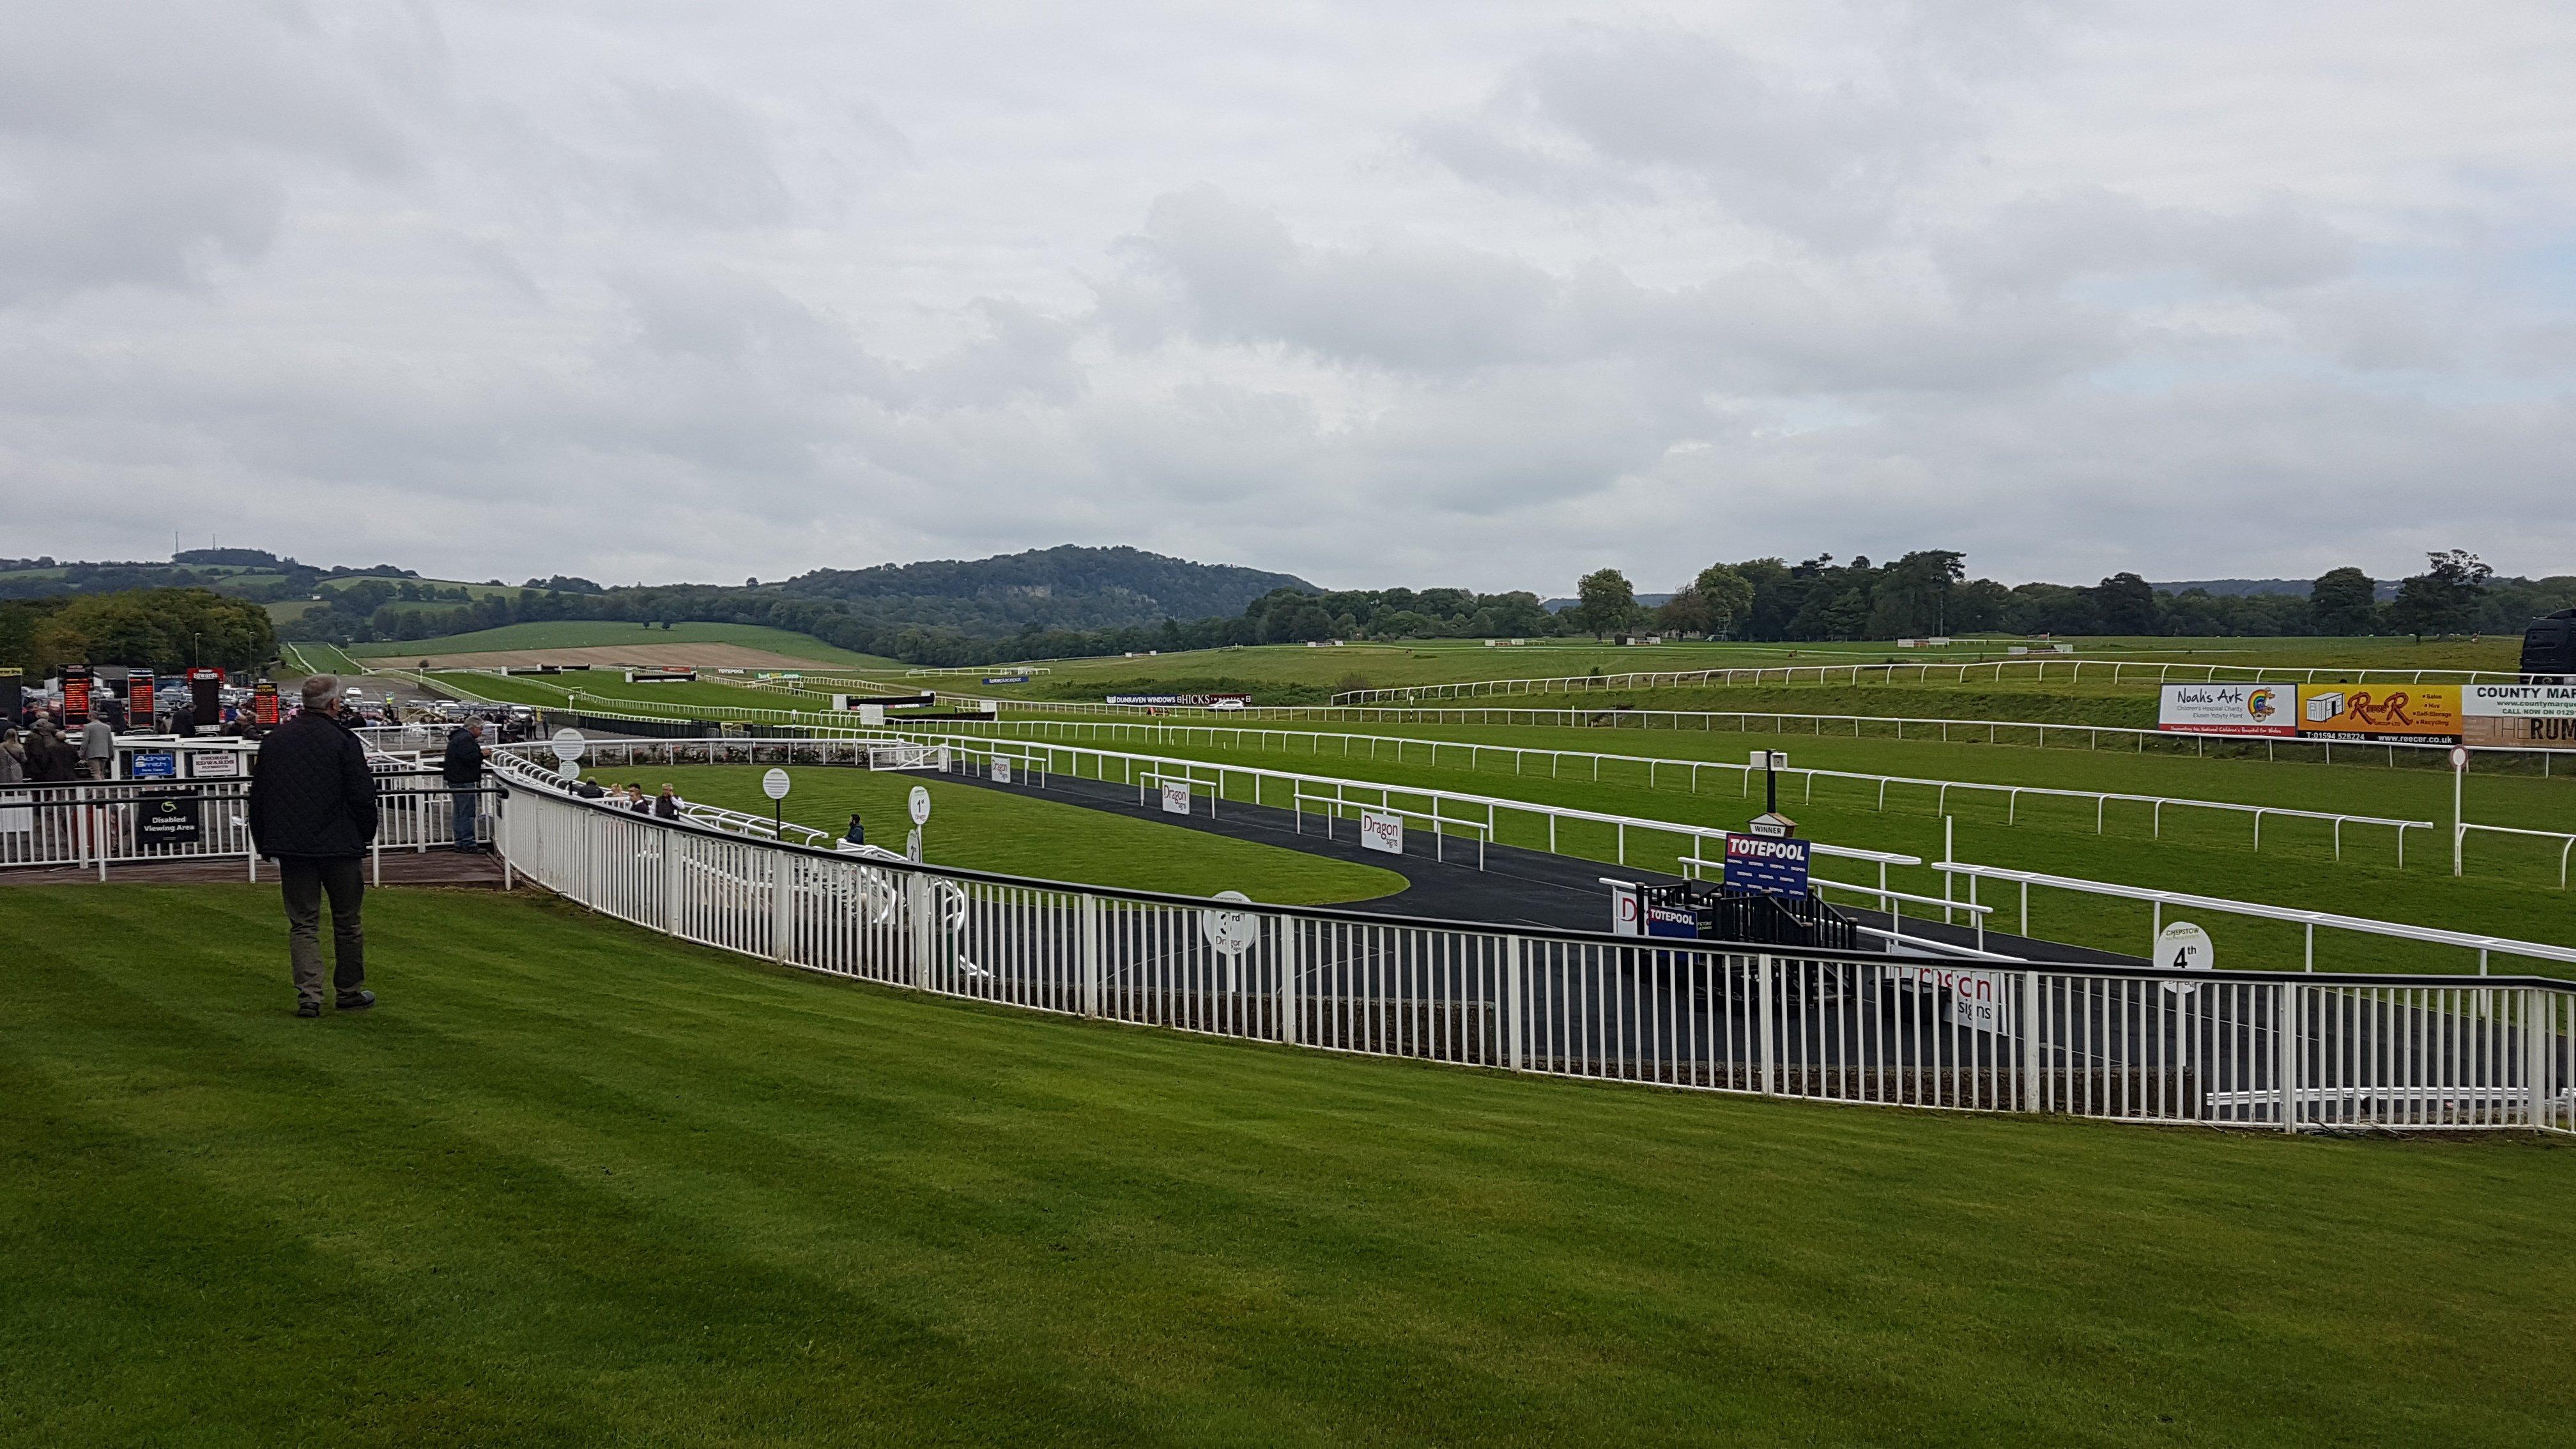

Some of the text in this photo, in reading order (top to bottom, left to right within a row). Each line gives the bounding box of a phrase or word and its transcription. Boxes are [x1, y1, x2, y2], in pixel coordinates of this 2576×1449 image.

[1182, 694, 1210, 704] HICKS
[2177, 687, 2243, 703] Noah's Ark
[2477, 687, 2540, 698] COUNTY
[1164, 785, 1186, 804] Dragon
[1364, 815, 1398, 839] Dragon
[1755, 825, 1781, 834] WINNER
[1730, 838, 1805, 861] TOTEPOOL
[1650, 909, 1694, 925] TOTEPOOL
[2166, 928, 2199, 939] CHEPSTOW
[2173, 946, 2196, 969] 4th
